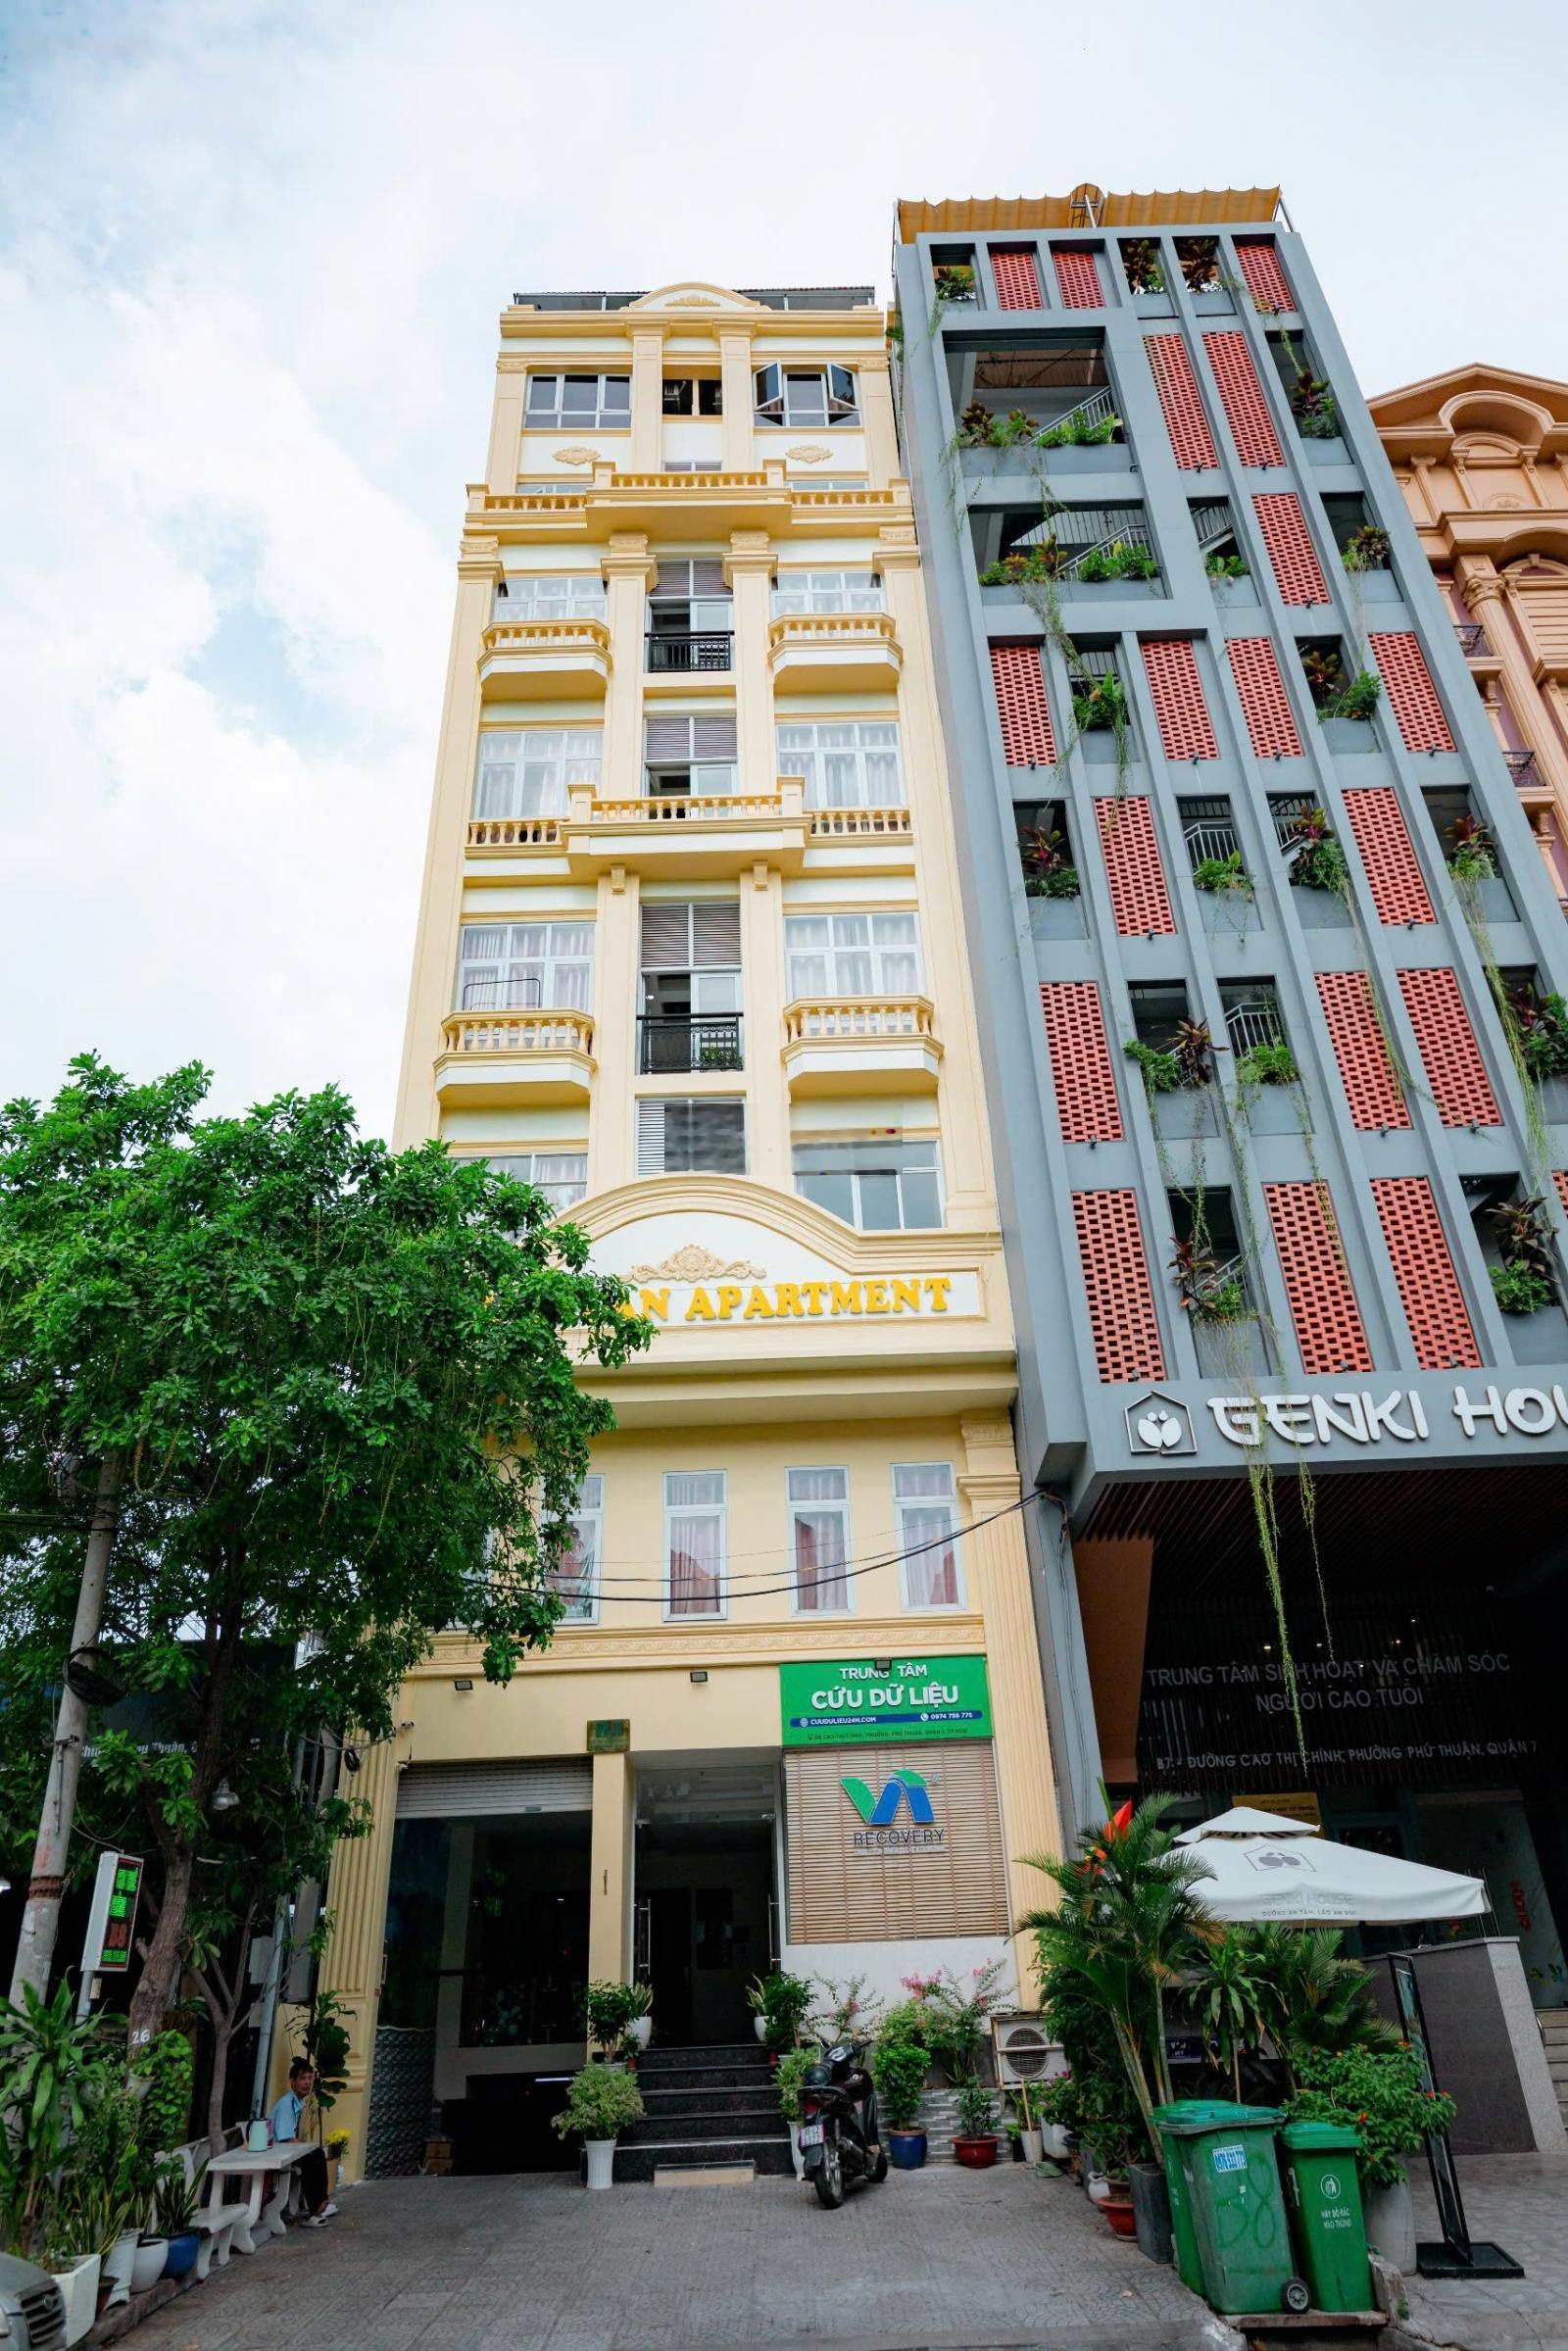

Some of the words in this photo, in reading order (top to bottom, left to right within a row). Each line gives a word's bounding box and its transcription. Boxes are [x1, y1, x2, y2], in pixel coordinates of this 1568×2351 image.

[684, 1276, 952, 1321] APARTMENT
[1206, 1390, 1430, 1446] GENKI
[840, 1666, 890, 1681] TRUNG
[897, 1662, 928, 1678] TÂM
[1145, 1665, 1214, 1687] TRUNG
[1216, 1660, 1260, 1684] TÂM
[1264, 1661, 1309, 1683] SIH
[1313, 1659, 1366, 1684] HOẠT
[1371, 1653, 1399, 1677] VÀ
[811, 1685, 863, 1709] CỨU
[869, 1683, 904, 1707] DỮ
[909, 1681, 959, 1708] LIỆU
[1327, 1689, 1372, 1710] CAO
[1375, 1677, 1425, 1707] TUỔI
[1240, 1753, 1272, 1768] CAO
[853, 1828, 945, 1847] RECOVERY
